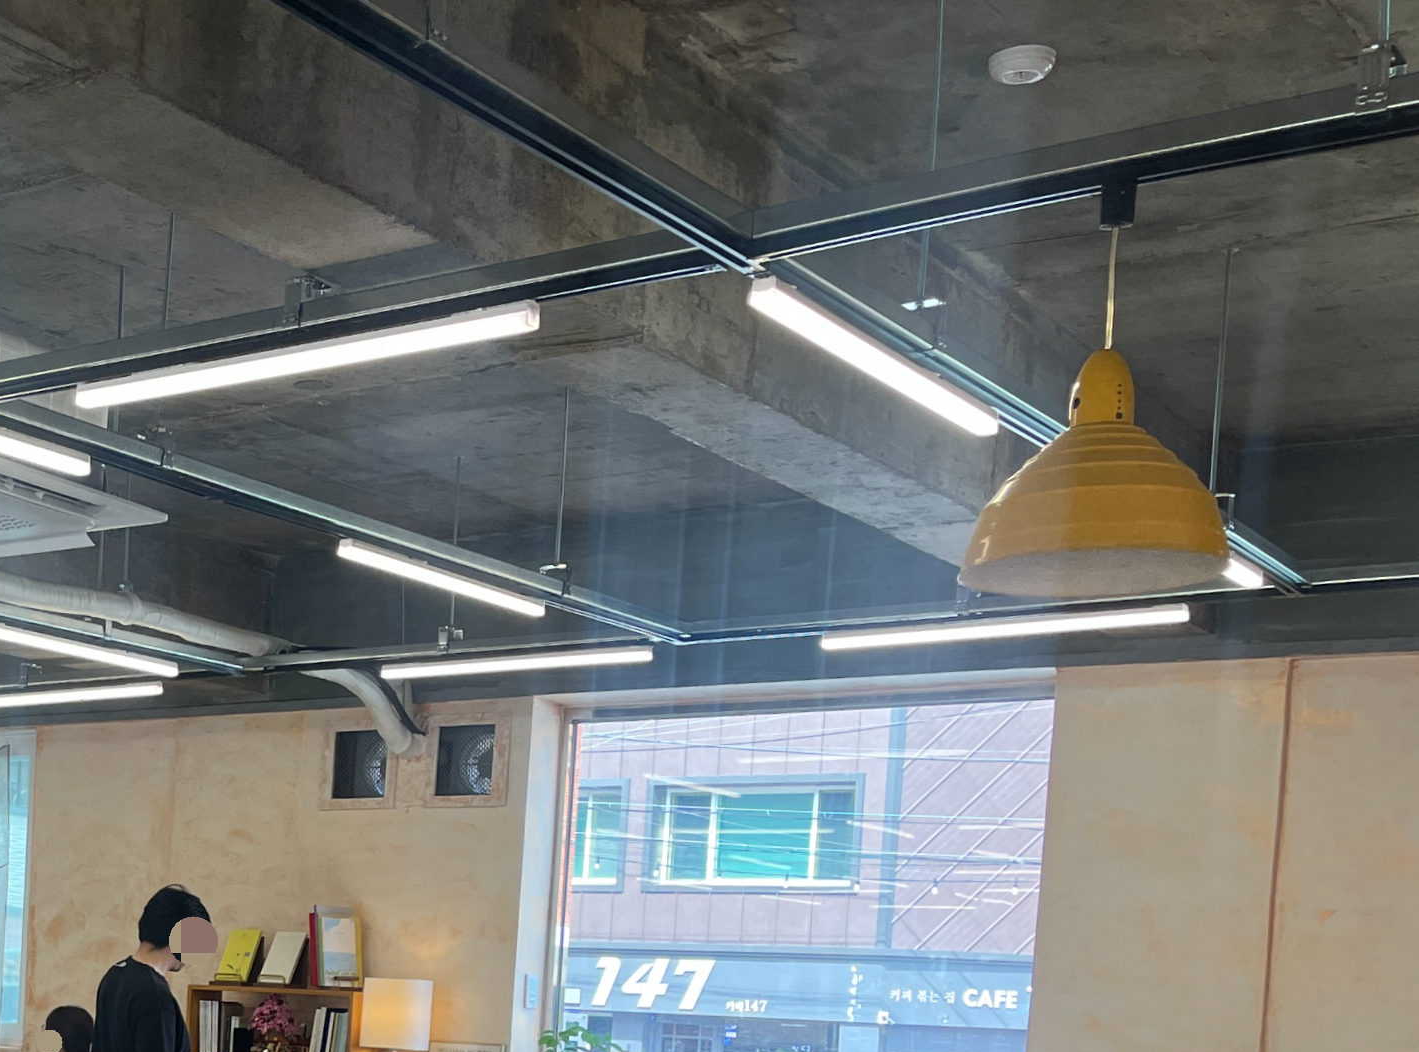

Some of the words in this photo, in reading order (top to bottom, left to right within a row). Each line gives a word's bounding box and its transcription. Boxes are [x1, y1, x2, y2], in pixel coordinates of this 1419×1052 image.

[591, 956, 717, 1011] 147
[889, 988, 912, 1002] 커피
[962, 987, 1019, 1009] CAFE
